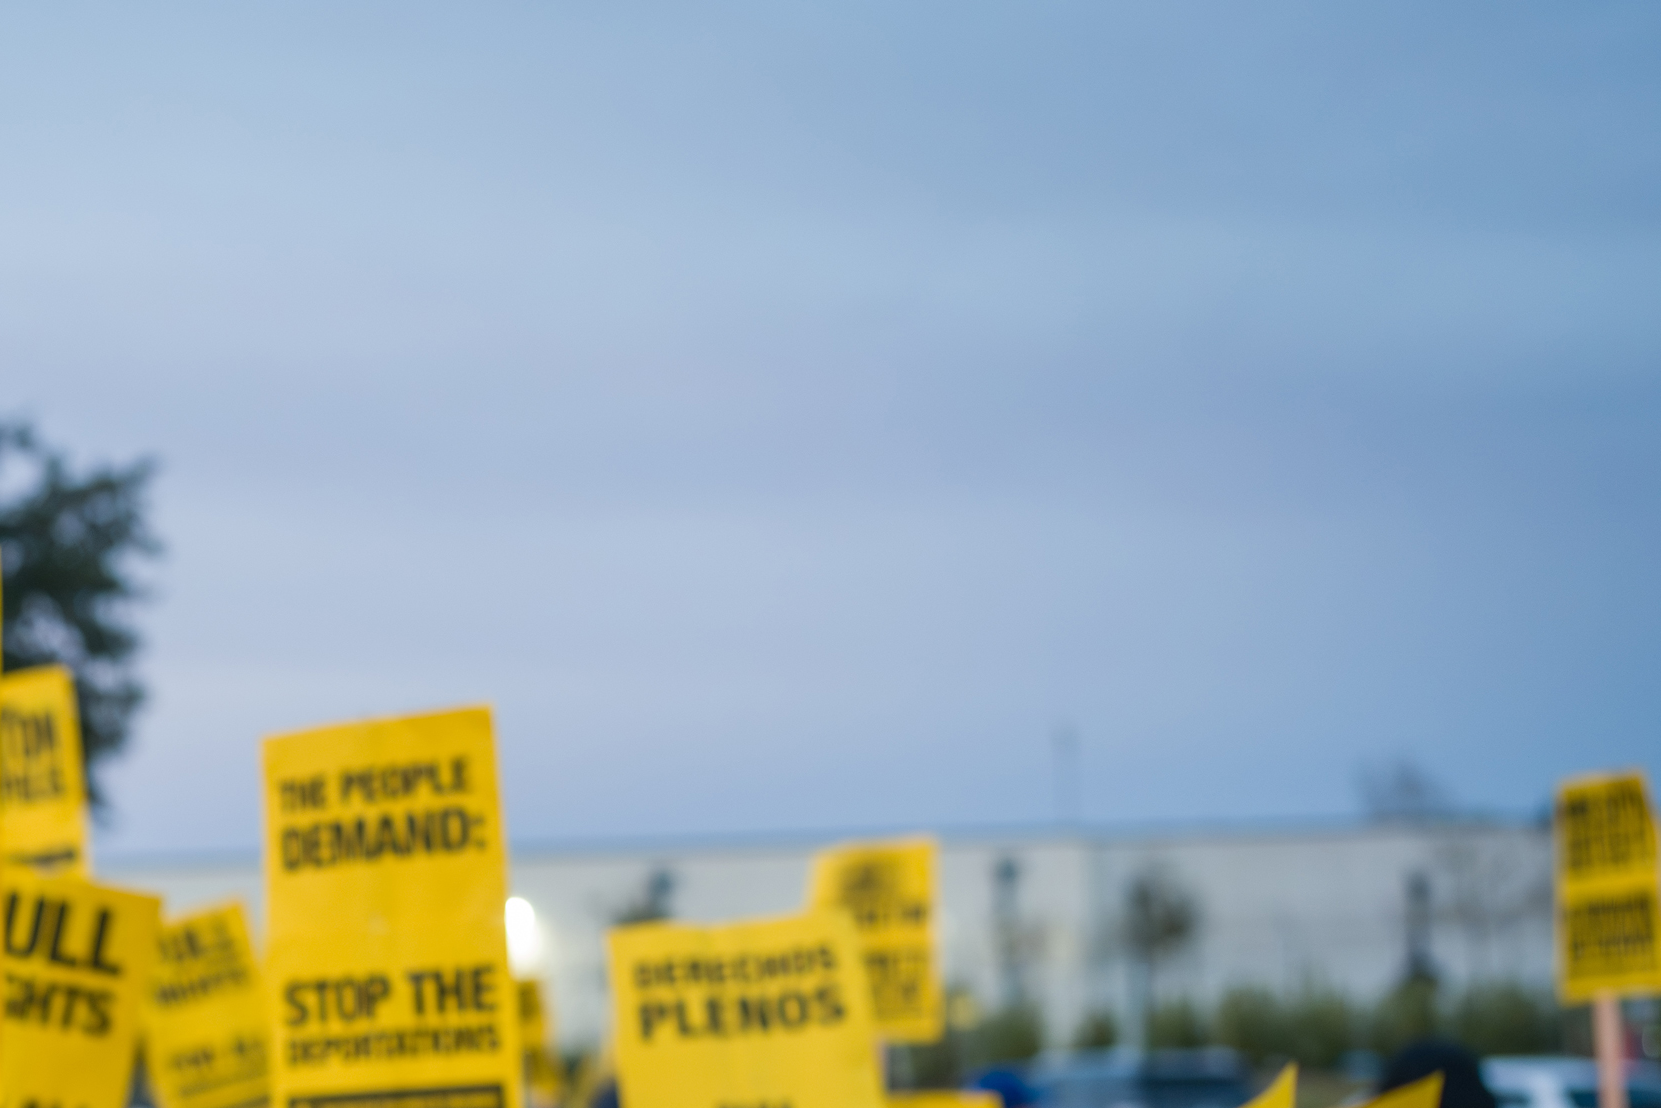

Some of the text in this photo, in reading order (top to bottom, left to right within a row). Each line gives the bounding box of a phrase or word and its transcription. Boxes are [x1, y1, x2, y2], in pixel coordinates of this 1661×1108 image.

[3, 890, 122, 979] ULL
[283, 973, 393, 1028] STOP
[408, 963, 497, 1017] THE
[638, 984, 847, 1043] PLENOS
